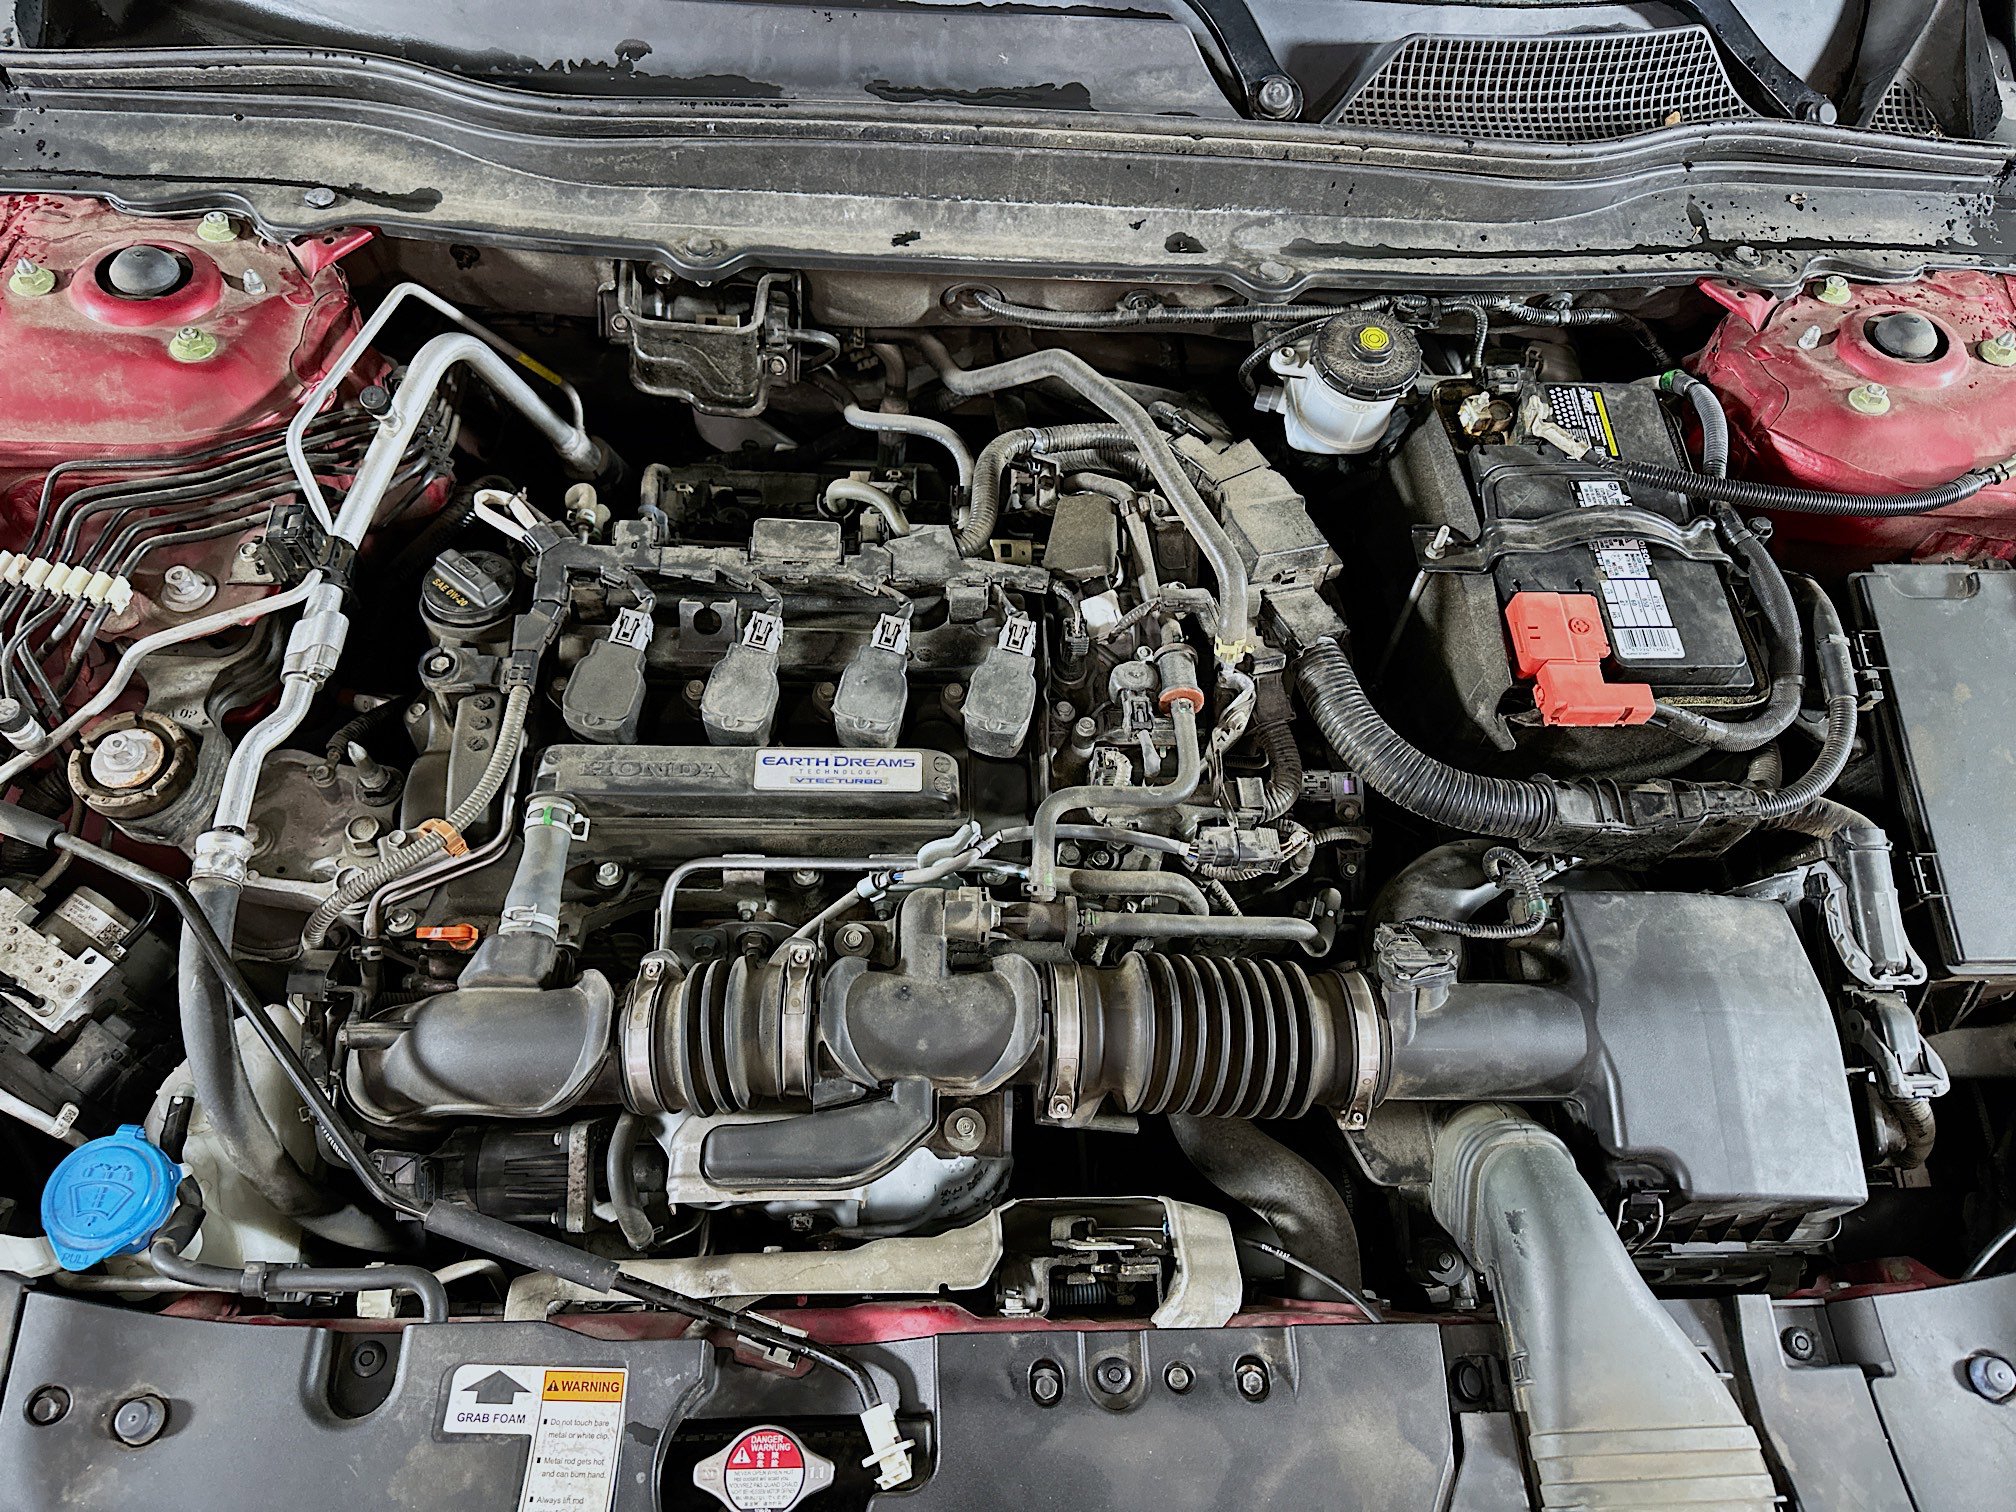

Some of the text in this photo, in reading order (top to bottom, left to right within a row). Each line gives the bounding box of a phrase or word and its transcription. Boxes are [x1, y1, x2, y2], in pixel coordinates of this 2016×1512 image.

[432, 578, 469, 607] SAE 0W-20
[762, 756, 916, 768] EARTH DREAMS
[579, 761, 731, 778] HONDA
[61, 1252, 90, 1265] PULL
[561, 1380, 620, 1393] WARNING
[457, 1412, 526, 1424] GRAB FOAM
[750, 1435, 784, 1443] DANGER
[750, 1443, 791, 1452] WARNUNG
[809, 1466, 824, 1479] 1.1
[536, 1497, 561, 1505] Always
